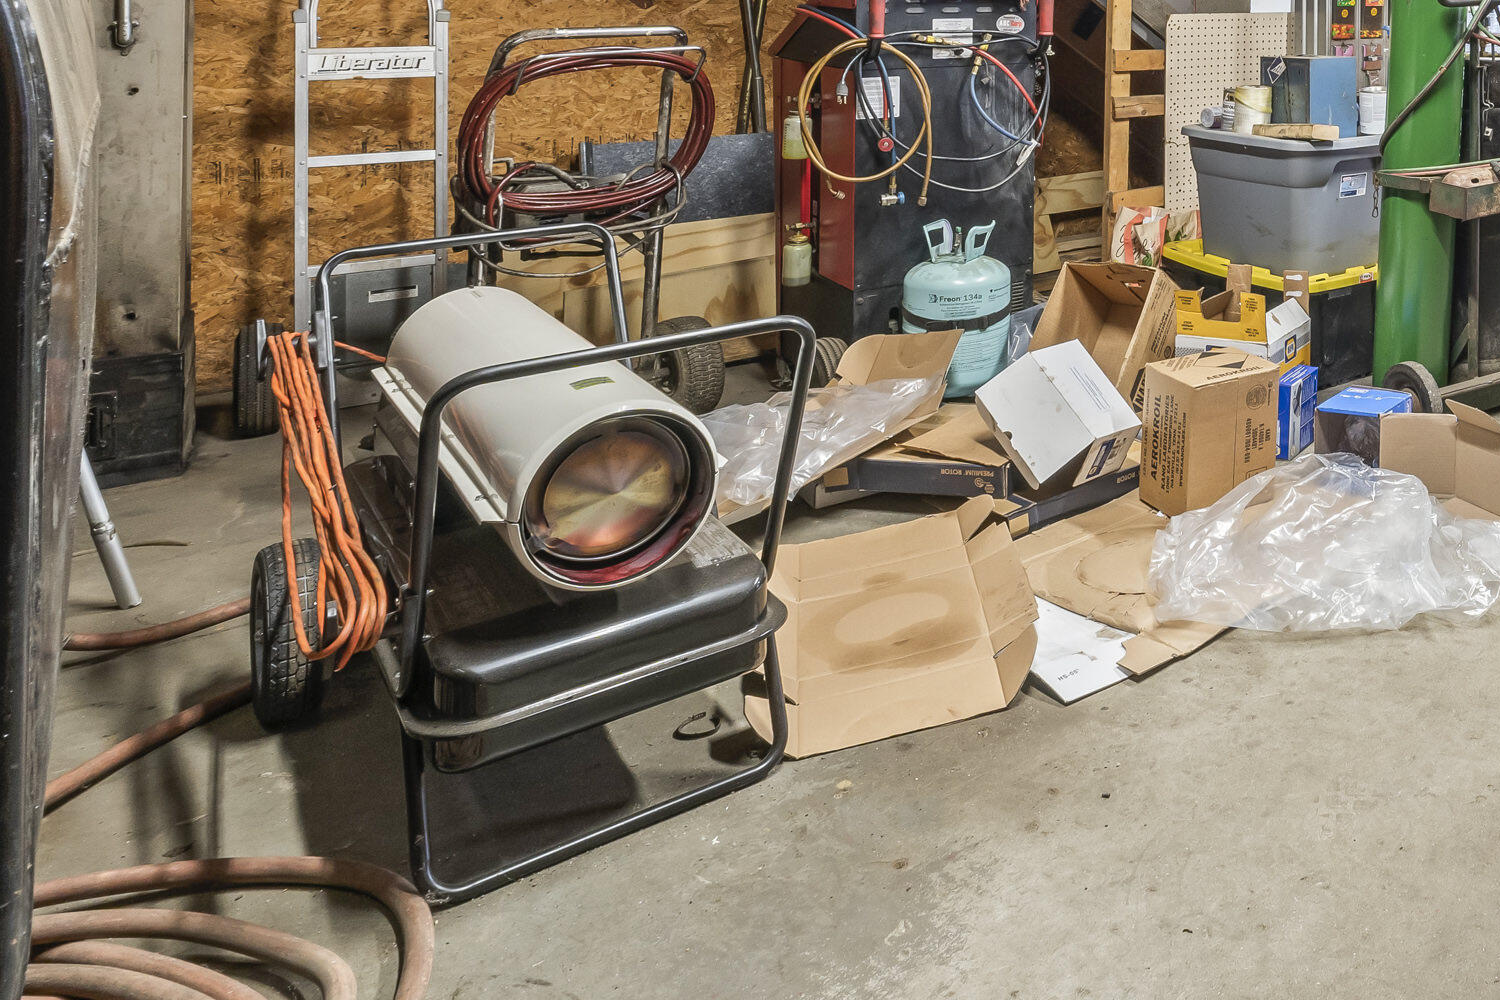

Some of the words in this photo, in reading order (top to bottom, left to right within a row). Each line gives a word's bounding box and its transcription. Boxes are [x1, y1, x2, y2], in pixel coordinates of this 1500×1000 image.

[317, 55, 427, 72] Liberator
[939, 295, 961, 303] Freon
[963, 293, 983, 301] 134a
[1206, 365, 1263, 381] AEROKROIL
[1162, 394, 1171, 463] LABORATORIES
[1150, 394, 1162, 481] AEROKROIL
[940, 468, 962, 476] ROTOR
[965, 468, 995, 477] PREMIUM
[1116, 471, 1136, 484] ROTOR
